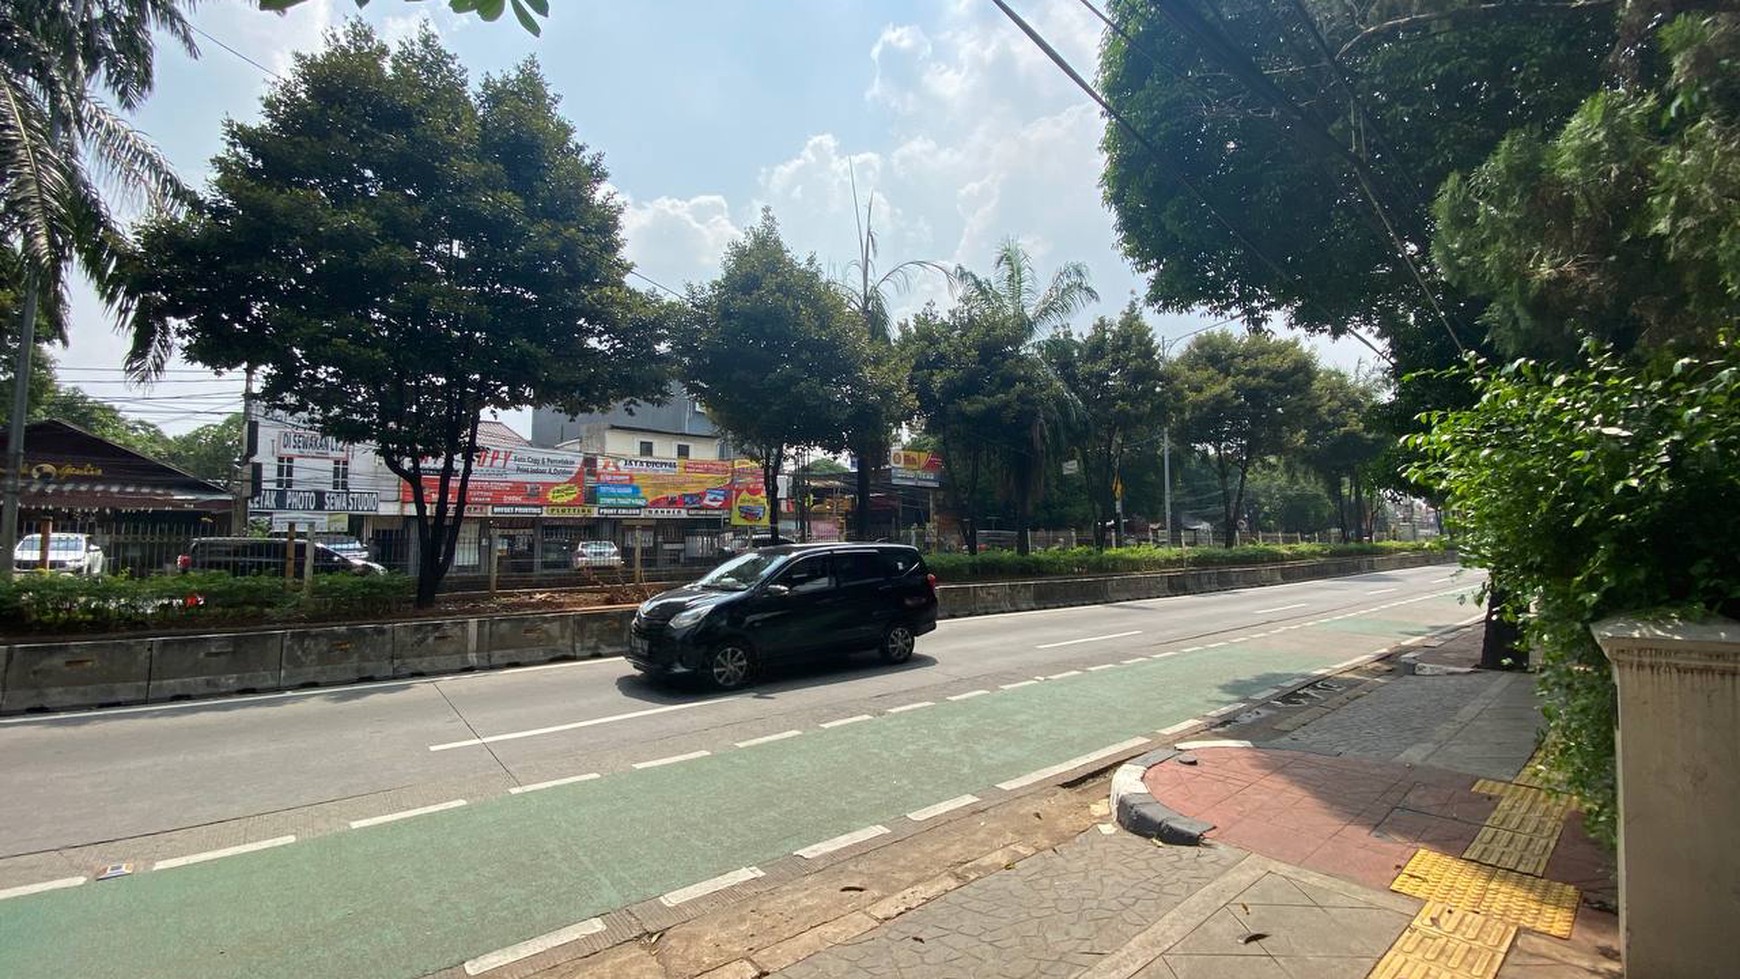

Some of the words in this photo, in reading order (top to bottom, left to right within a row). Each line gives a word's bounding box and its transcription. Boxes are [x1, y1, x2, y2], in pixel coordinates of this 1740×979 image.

[286, 491, 316, 509] PHOTO
[324, 492, 347, 511] SEWA
[348, 493, 378, 511] STUDIO
